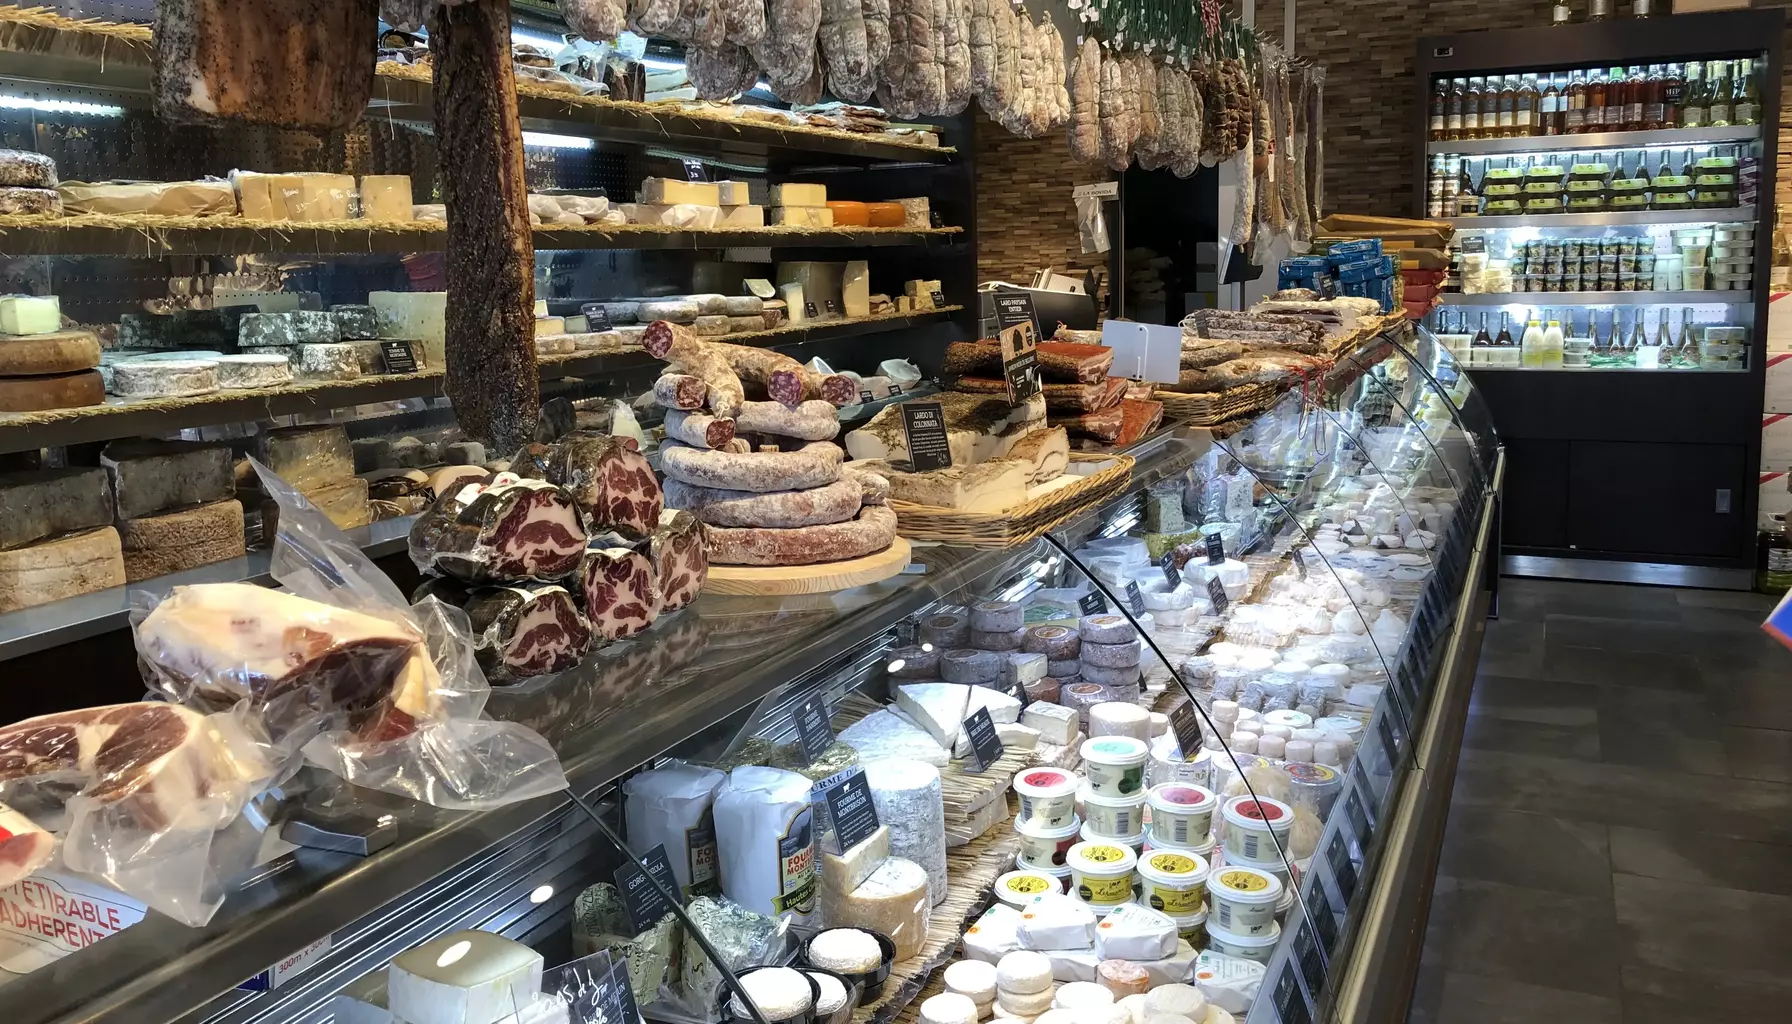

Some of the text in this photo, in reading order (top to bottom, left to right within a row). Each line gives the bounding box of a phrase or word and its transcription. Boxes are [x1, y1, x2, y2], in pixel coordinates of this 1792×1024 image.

[913, 420, 939, 429] COLONNATA
[914, 411, 927, 420] LARDO
[811, 774, 843, 792] URME
[837, 788, 863, 809] FOURME DE
[838, 795, 867, 819] MONTBRISON
[628, 862, 665, 890] GORGZOLA
[279, 954, 302, 974] 300m
